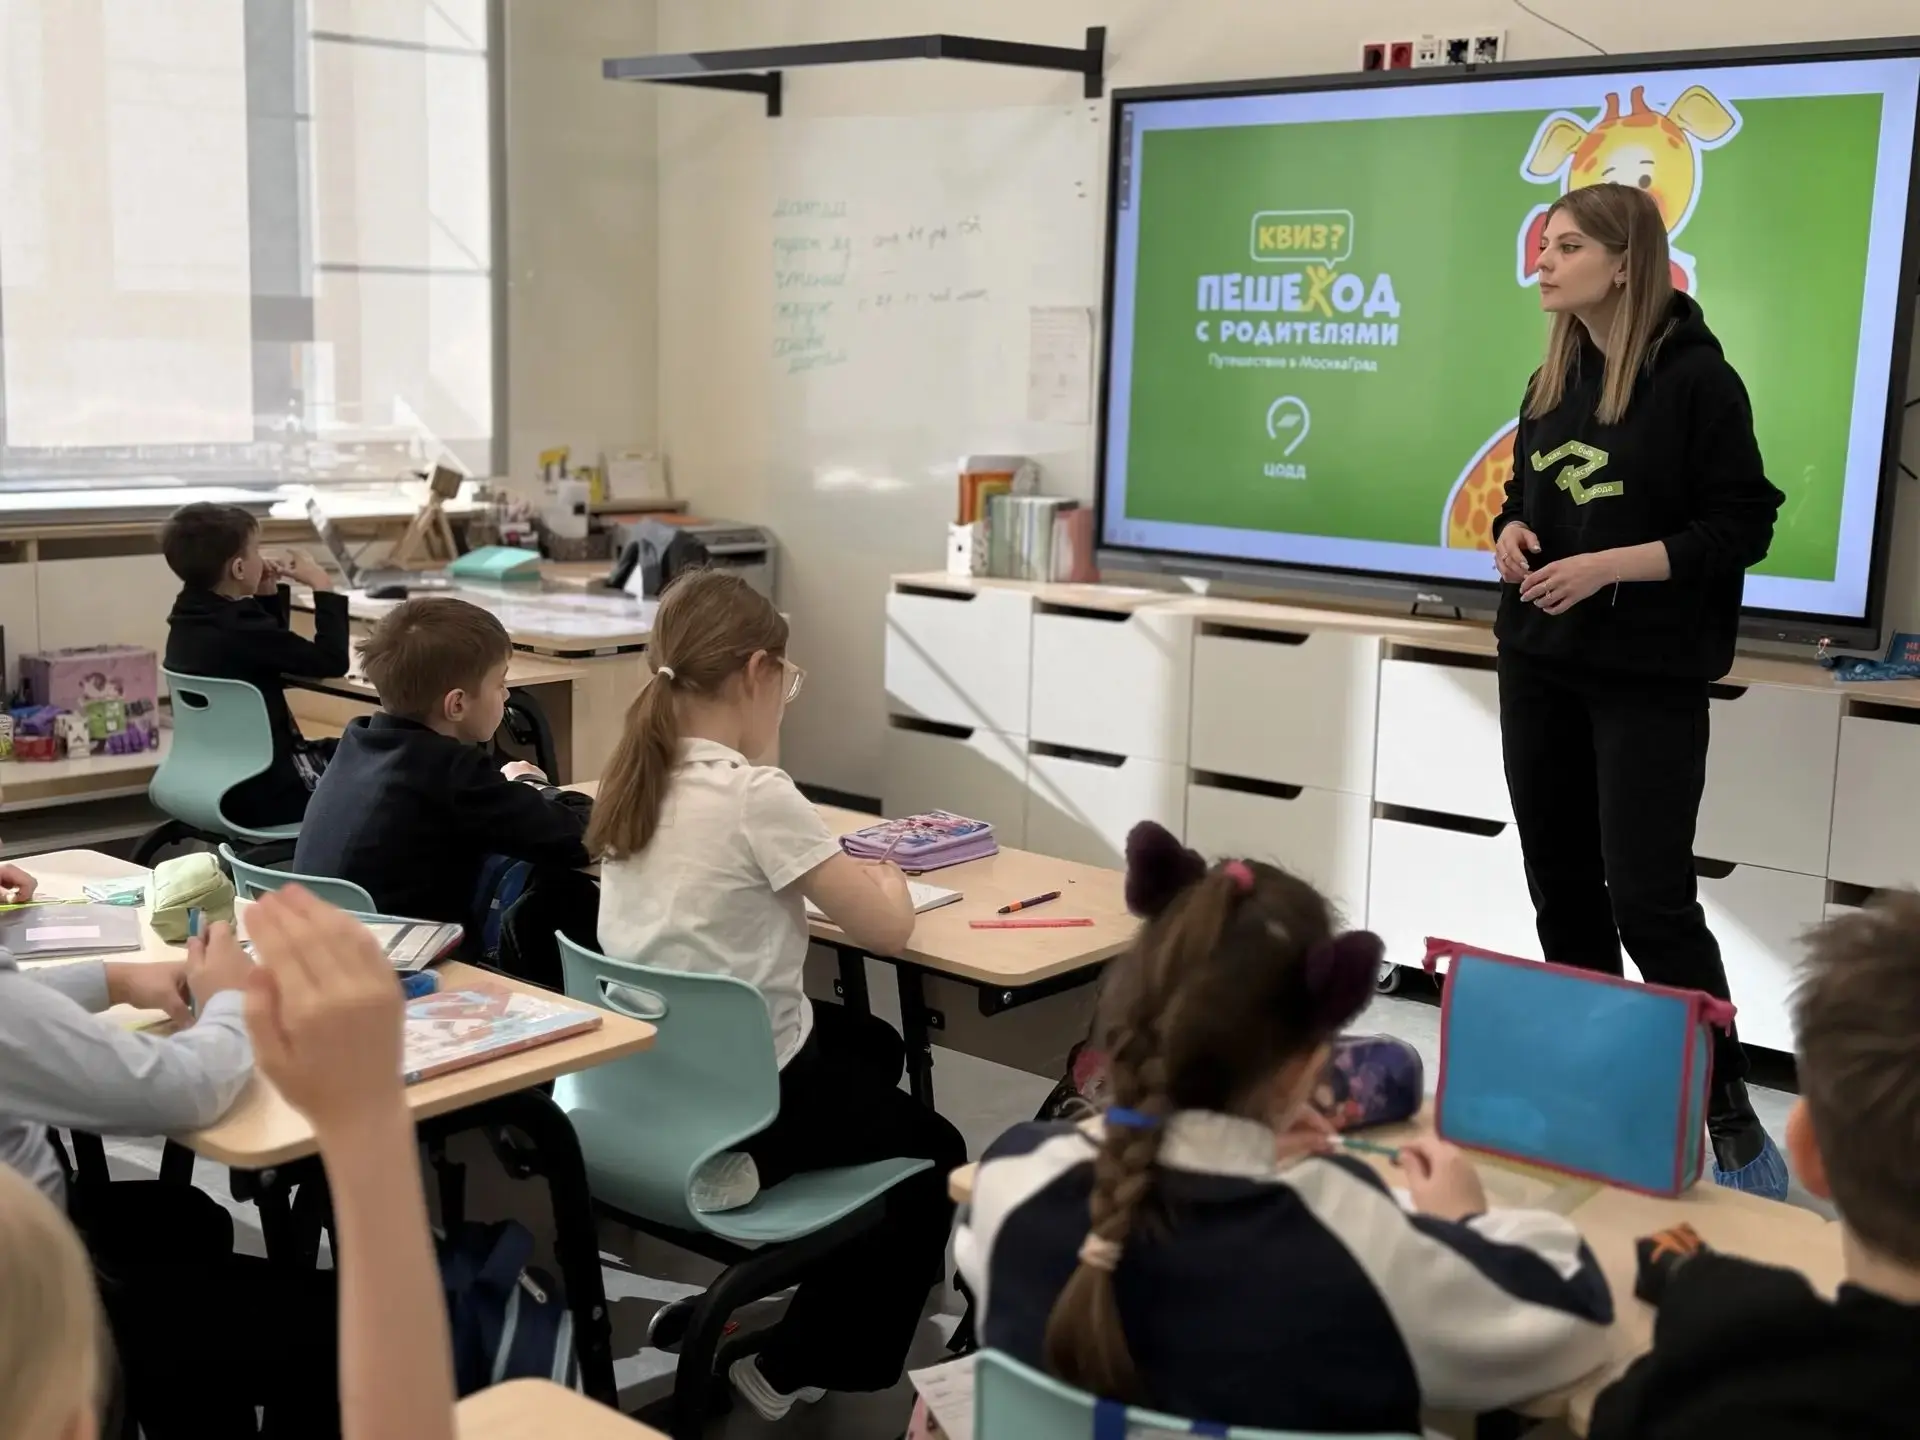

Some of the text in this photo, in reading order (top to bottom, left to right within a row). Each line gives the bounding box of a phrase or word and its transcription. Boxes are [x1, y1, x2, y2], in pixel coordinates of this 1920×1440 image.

[1258, 224, 1345, 250] КВИЗ?
[1197, 266, 1400, 318] ПЕШЕХОД
[1196, 320, 1399, 346] С РОДИТЕЛЯМИ
